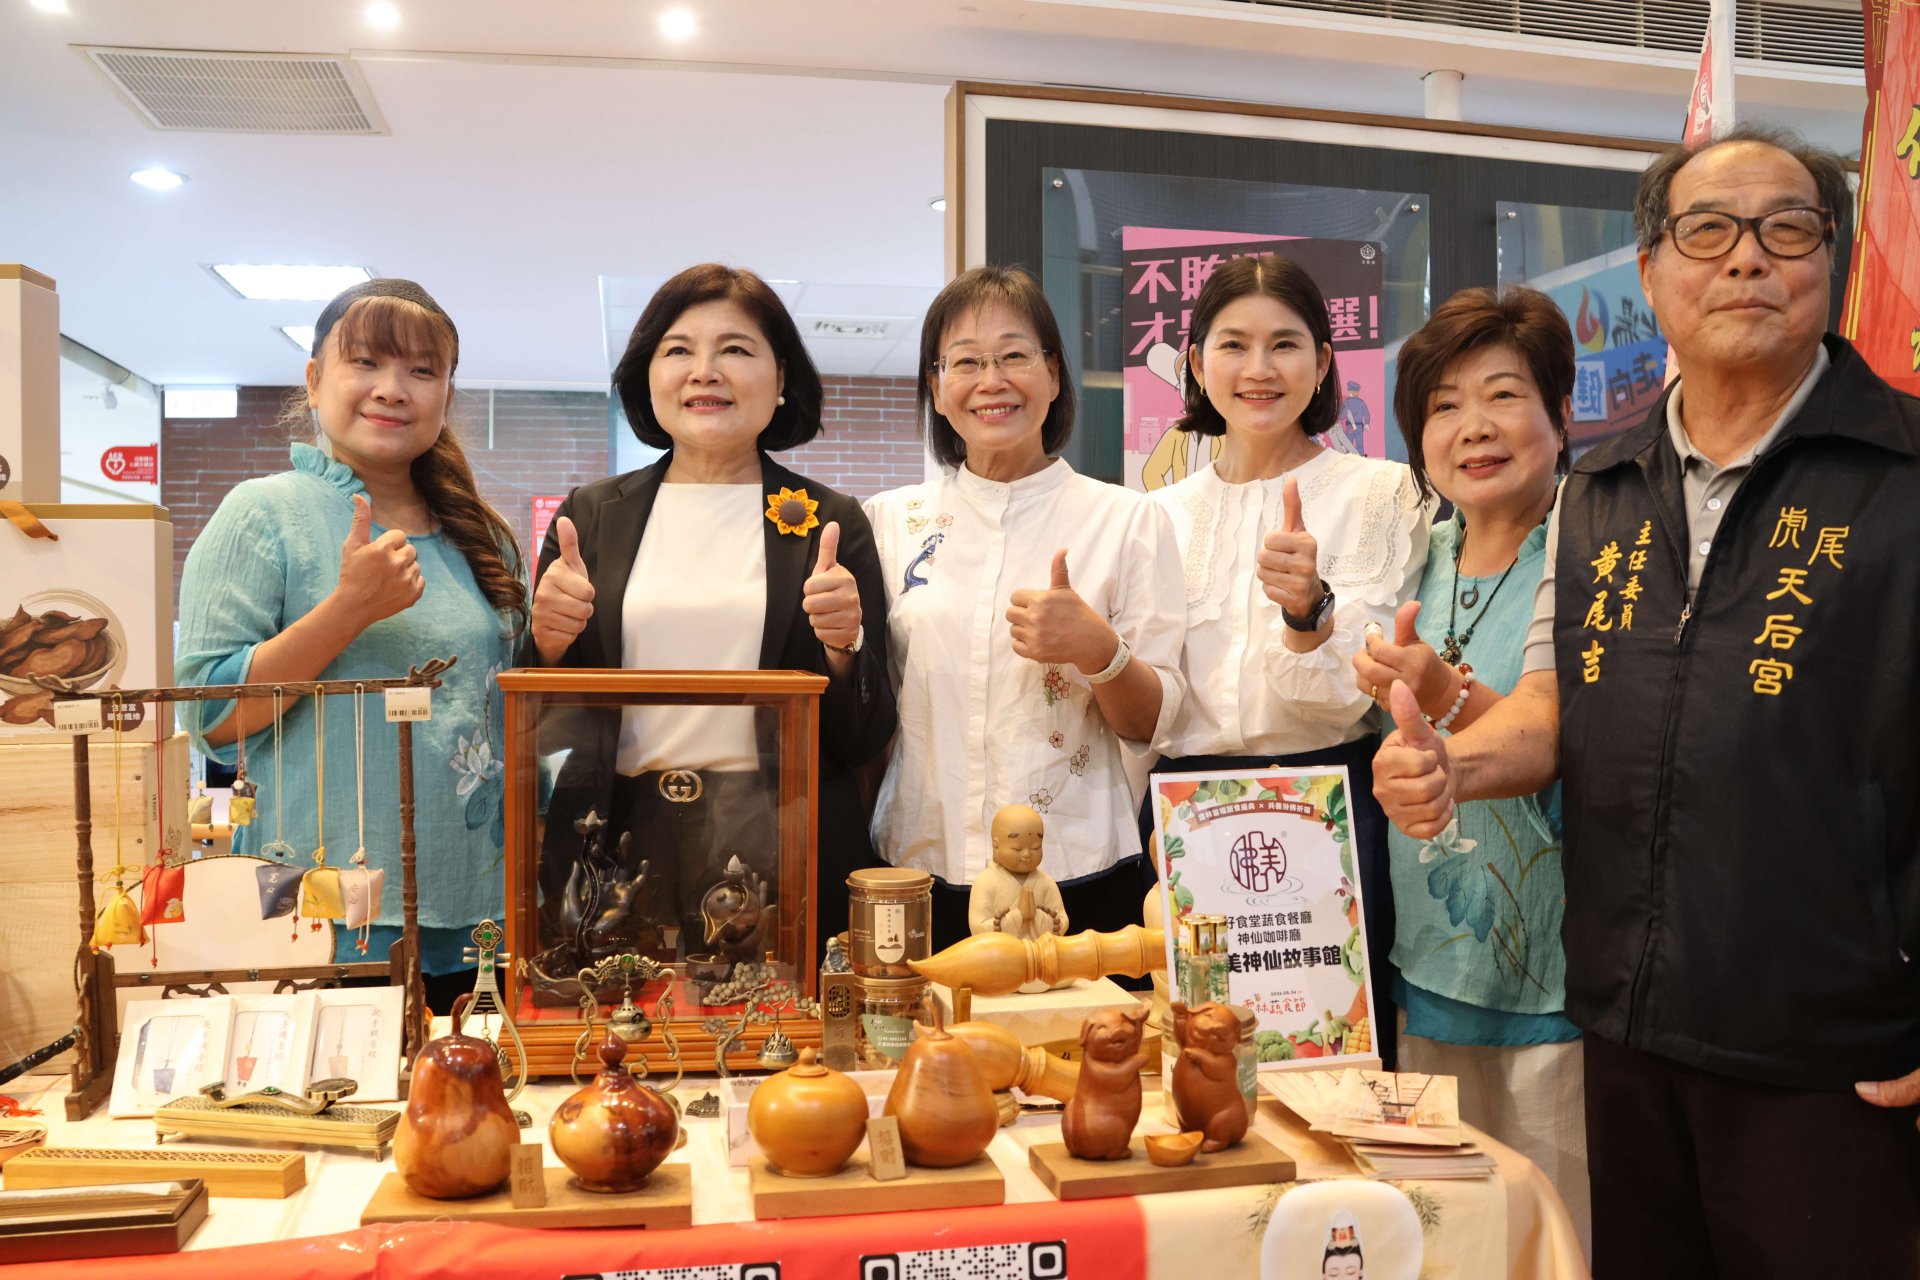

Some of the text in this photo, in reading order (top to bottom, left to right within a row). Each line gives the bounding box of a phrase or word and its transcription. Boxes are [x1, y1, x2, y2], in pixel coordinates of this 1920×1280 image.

[1129, 252, 1275, 304] 不賄
[1617, 519, 1653, 632] 主任委員
[1237, 928, 1302, 946] 神仙咖啡廳
